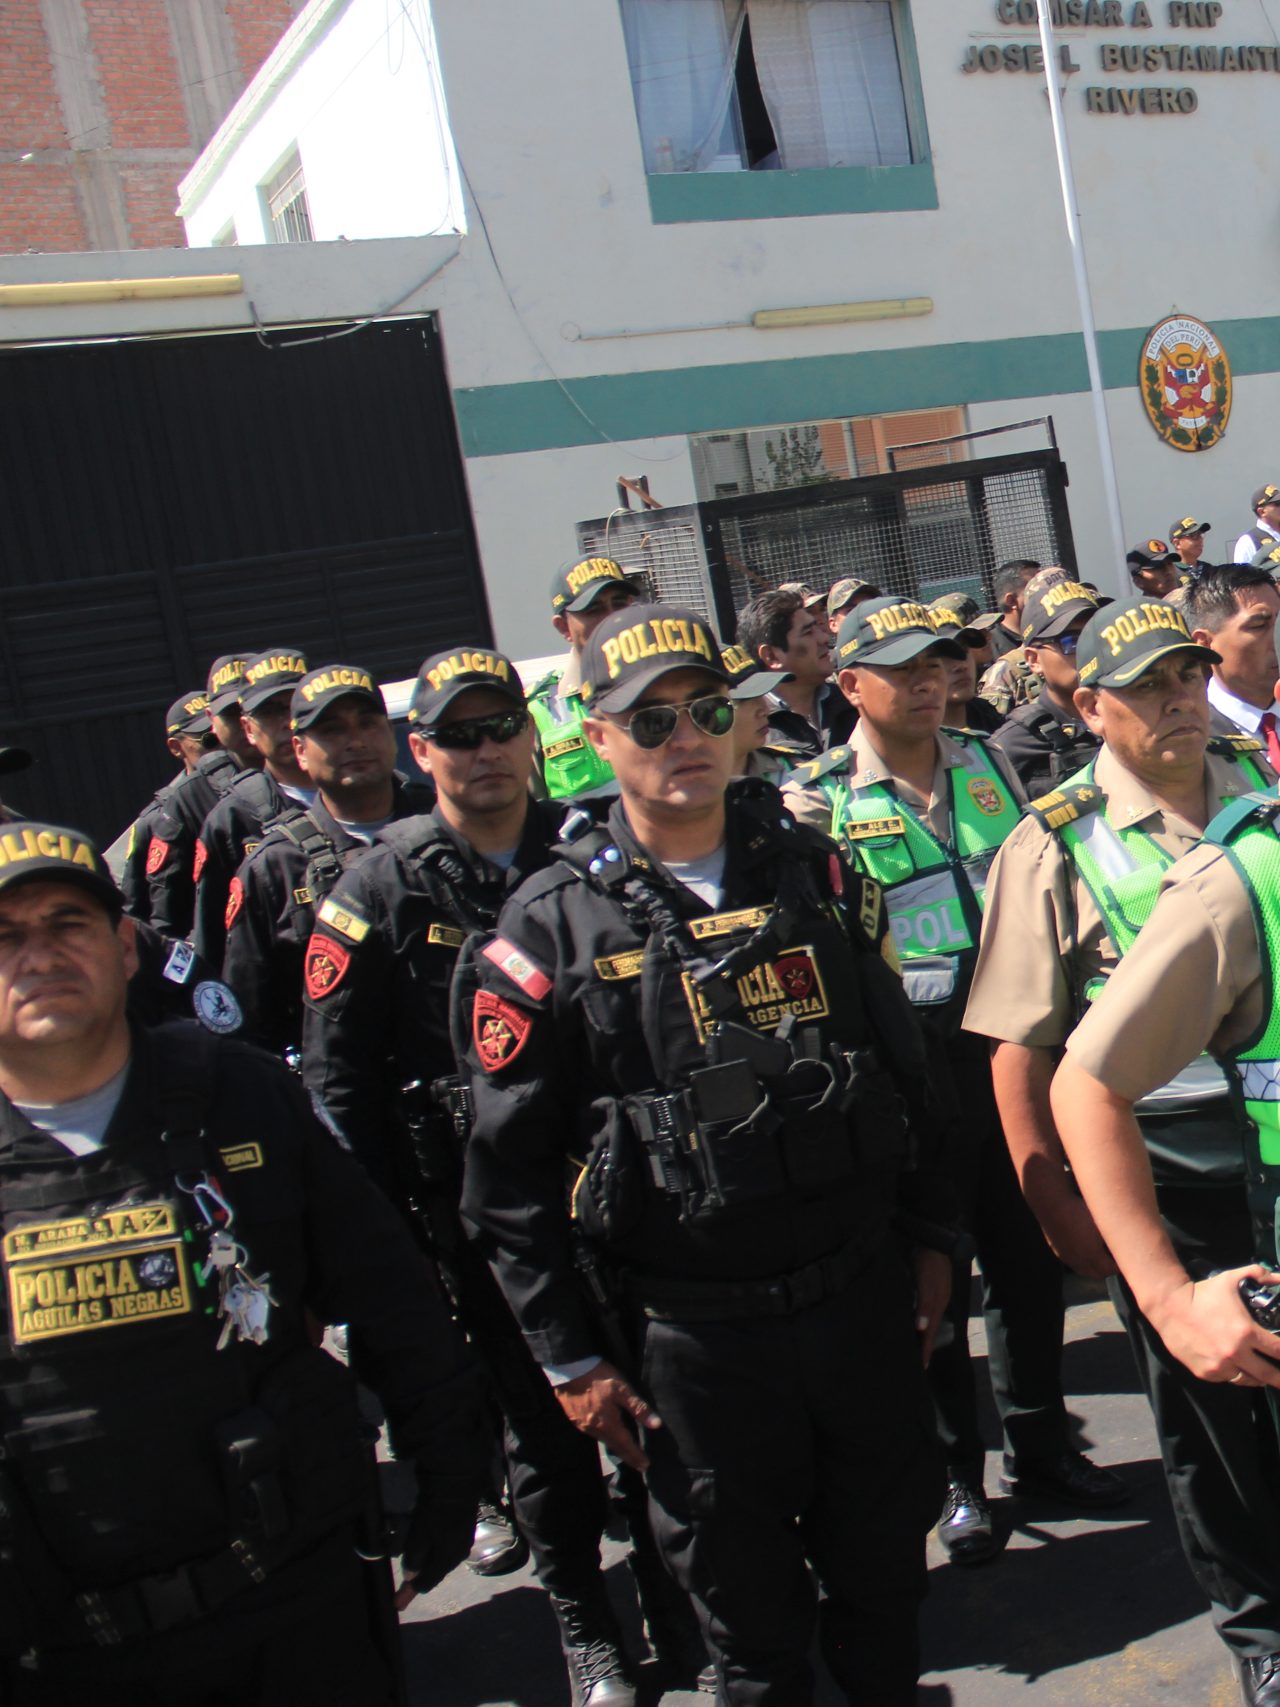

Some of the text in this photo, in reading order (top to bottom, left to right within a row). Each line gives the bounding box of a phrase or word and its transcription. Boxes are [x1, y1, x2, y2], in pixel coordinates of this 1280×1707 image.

[1168, 1, 1224, 28] PNP
[961, 44, 1044, 73] JOSE
[1061, 44, 1081, 73] L
[1086, 86, 1199, 115] RIVERO
[1148, 320, 1218, 355] POLICIA NACIONAL
[1164, 333, 1180, 348] DEL
[1101, 602, 1192, 657] POLICIA
[601, 618, 712, 680] POLICIA
[246, 656, 308, 687] POLICIA
[301, 669, 373, 703] POLICIA
[427, 652, 510, 693] POLICIA
[0, 829, 97, 872] LICIA
[889, 906, 966, 950] POL
[37, 1224, 88, 1244] ARANA
[17, 1258, 140, 1313] POLICIA
[21, 1287, 184, 1334] AGUILAS NEGRAS
